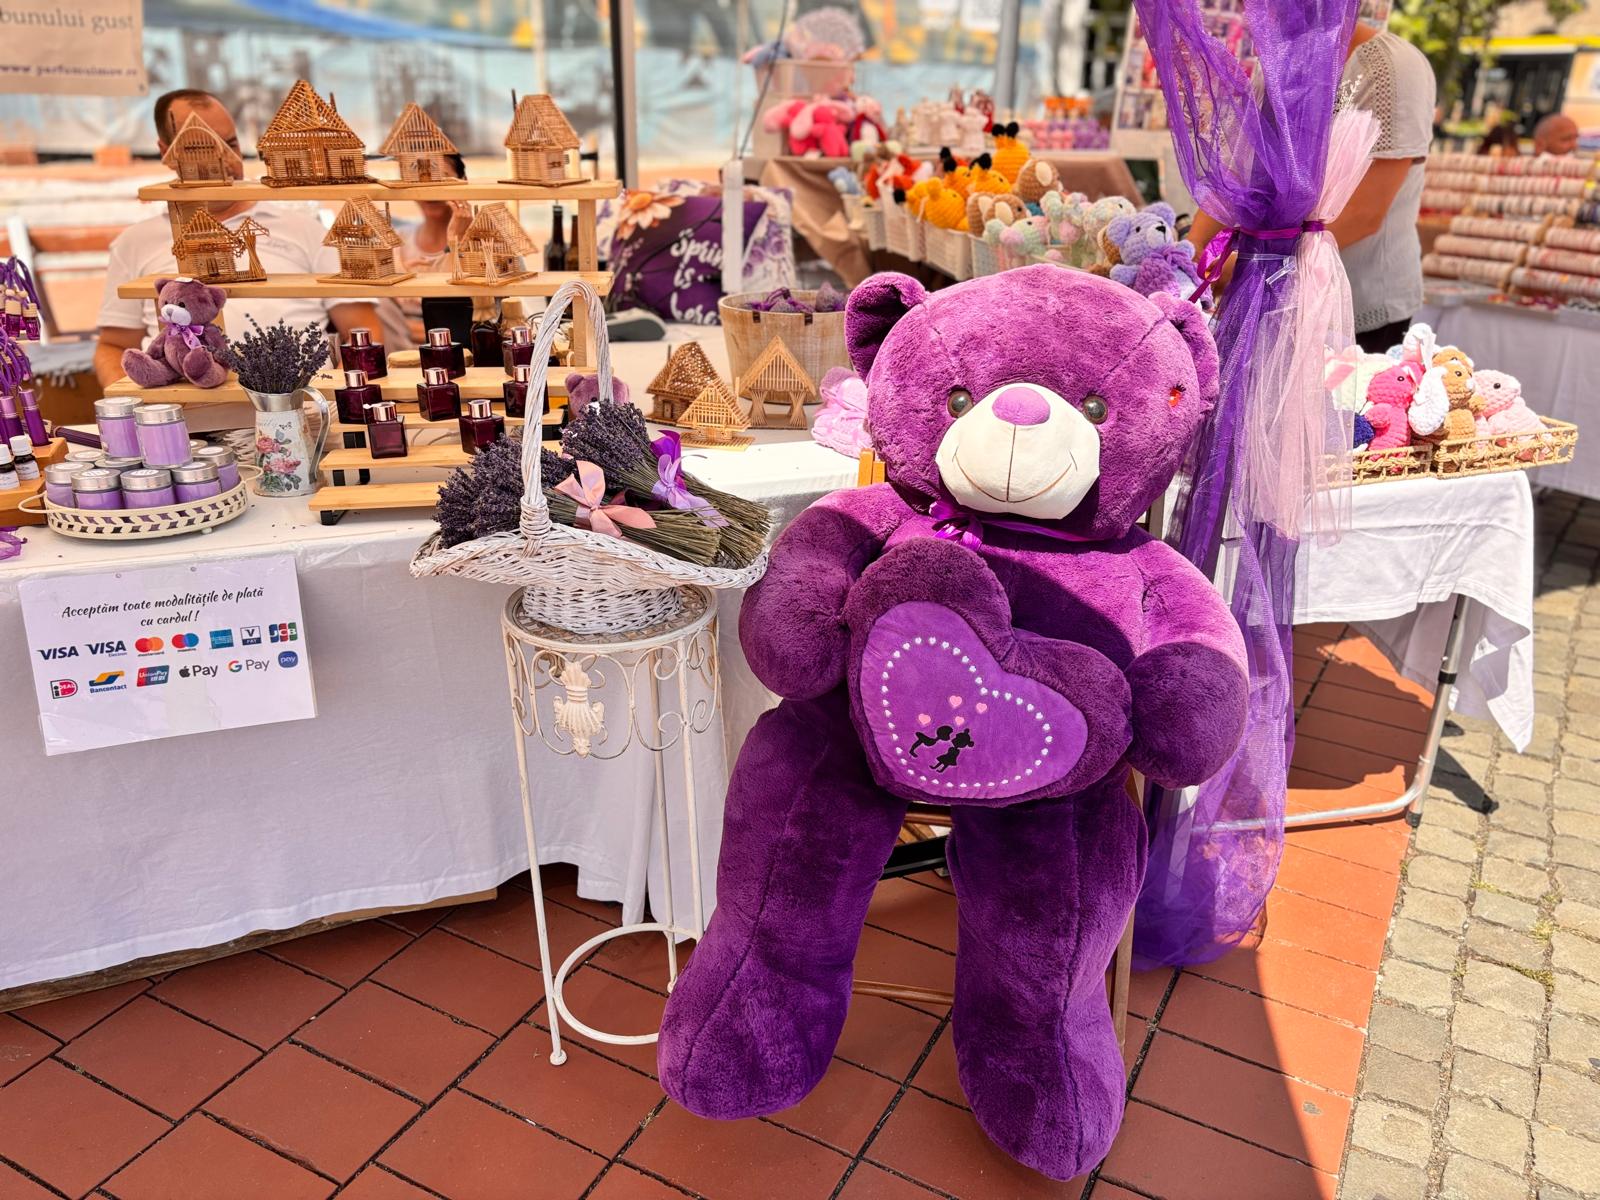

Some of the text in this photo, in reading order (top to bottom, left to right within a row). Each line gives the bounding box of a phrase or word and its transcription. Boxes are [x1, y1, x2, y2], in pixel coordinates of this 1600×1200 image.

[91, 15, 133, 35] gust
[62, 603, 119, 619] Acceptăm
[123, 600, 152, 611] toate
[221, 589, 234, 601] de
[236, 586, 264, 603] plată
[140, 618, 153, 627] cu
[156, 610, 193, 625] cardul
[36, 646, 79, 660] VISA
[85, 640, 127, 655] VISA
[90, 684, 127, 694] Bancontact
[192, 664, 219, 678] Pay
[245, 659, 270, 672] Pay
